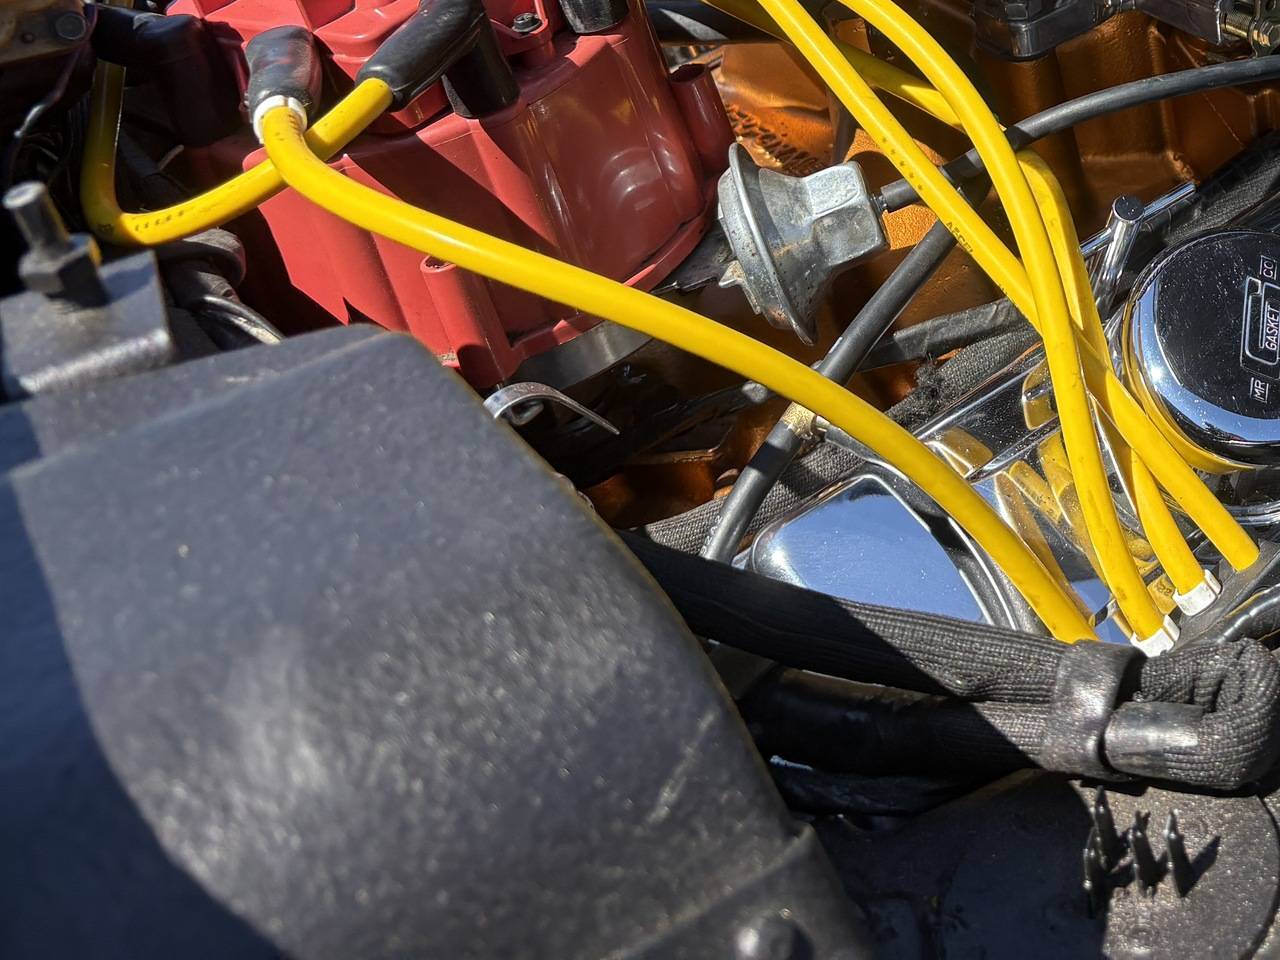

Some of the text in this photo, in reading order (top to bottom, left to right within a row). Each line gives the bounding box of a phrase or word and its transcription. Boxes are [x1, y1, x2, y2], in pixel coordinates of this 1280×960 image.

[1253, 260, 1280, 402] MR GASKET CO
